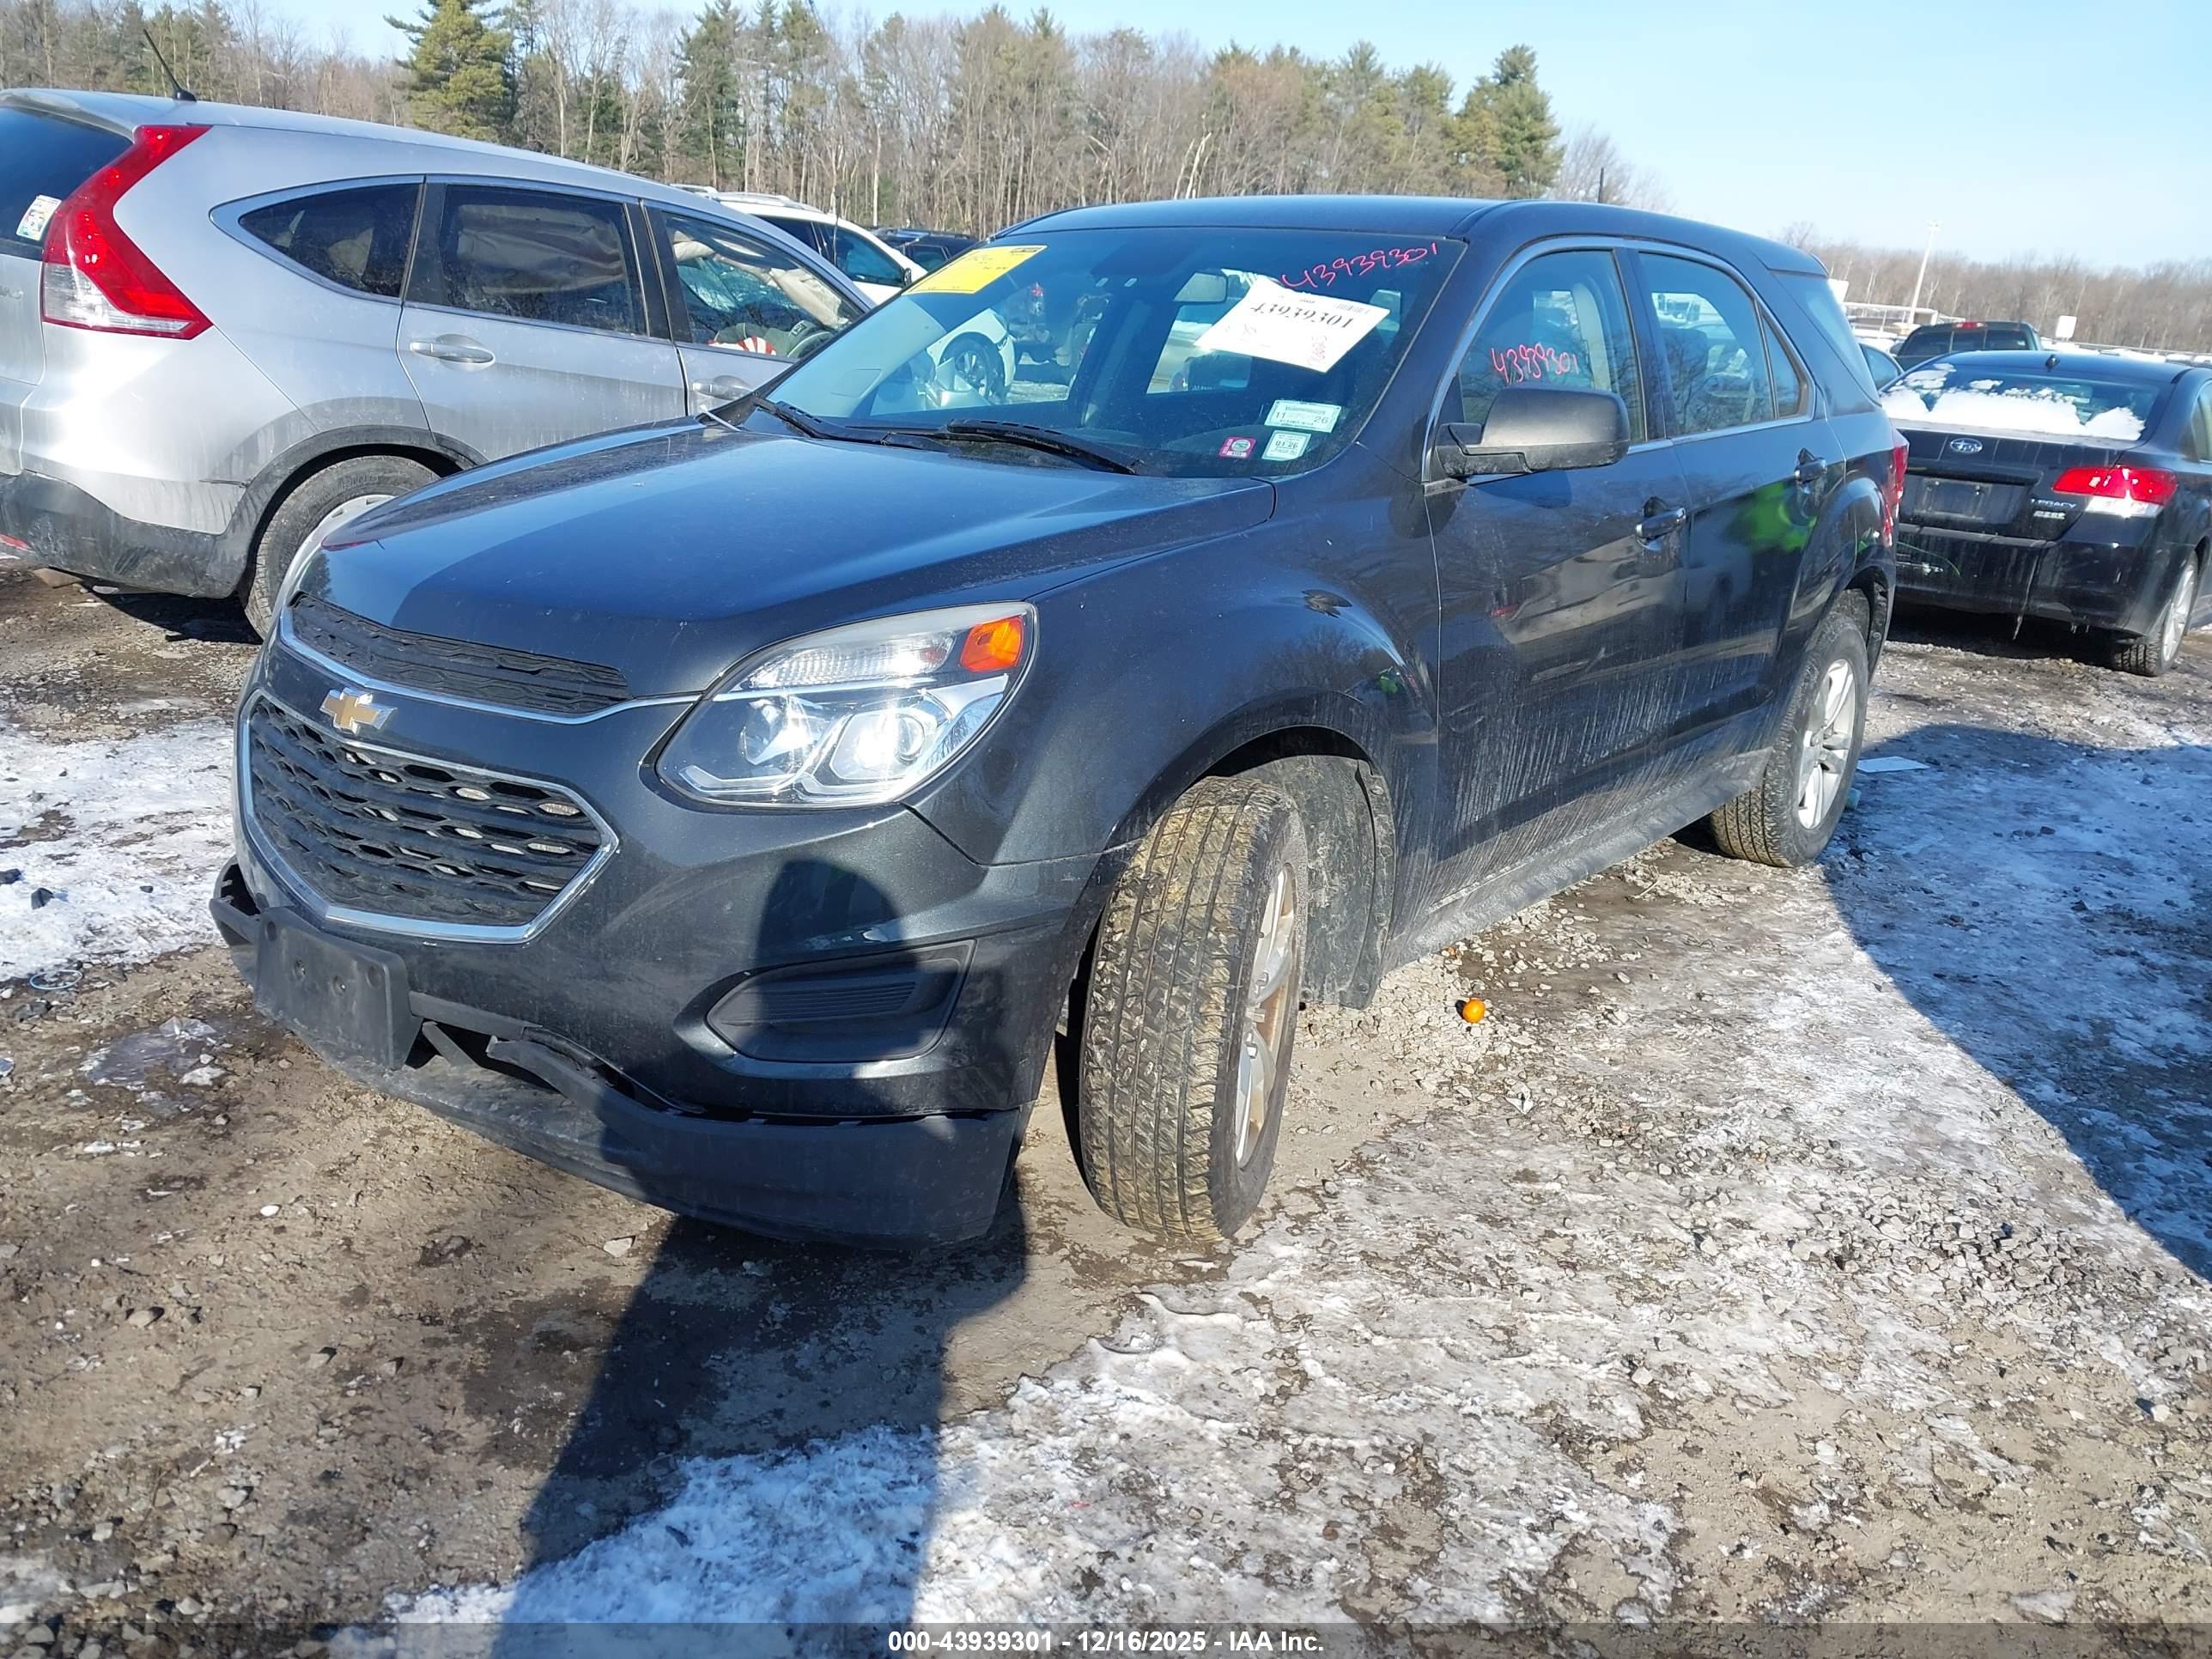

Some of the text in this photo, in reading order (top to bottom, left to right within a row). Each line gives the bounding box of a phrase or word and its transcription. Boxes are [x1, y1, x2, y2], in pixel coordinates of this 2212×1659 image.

[1281, 242, 1437, 289] 43939301
[1250, 301, 1354, 329] 43939301
[1490, 343, 1579, 385] 43939301
